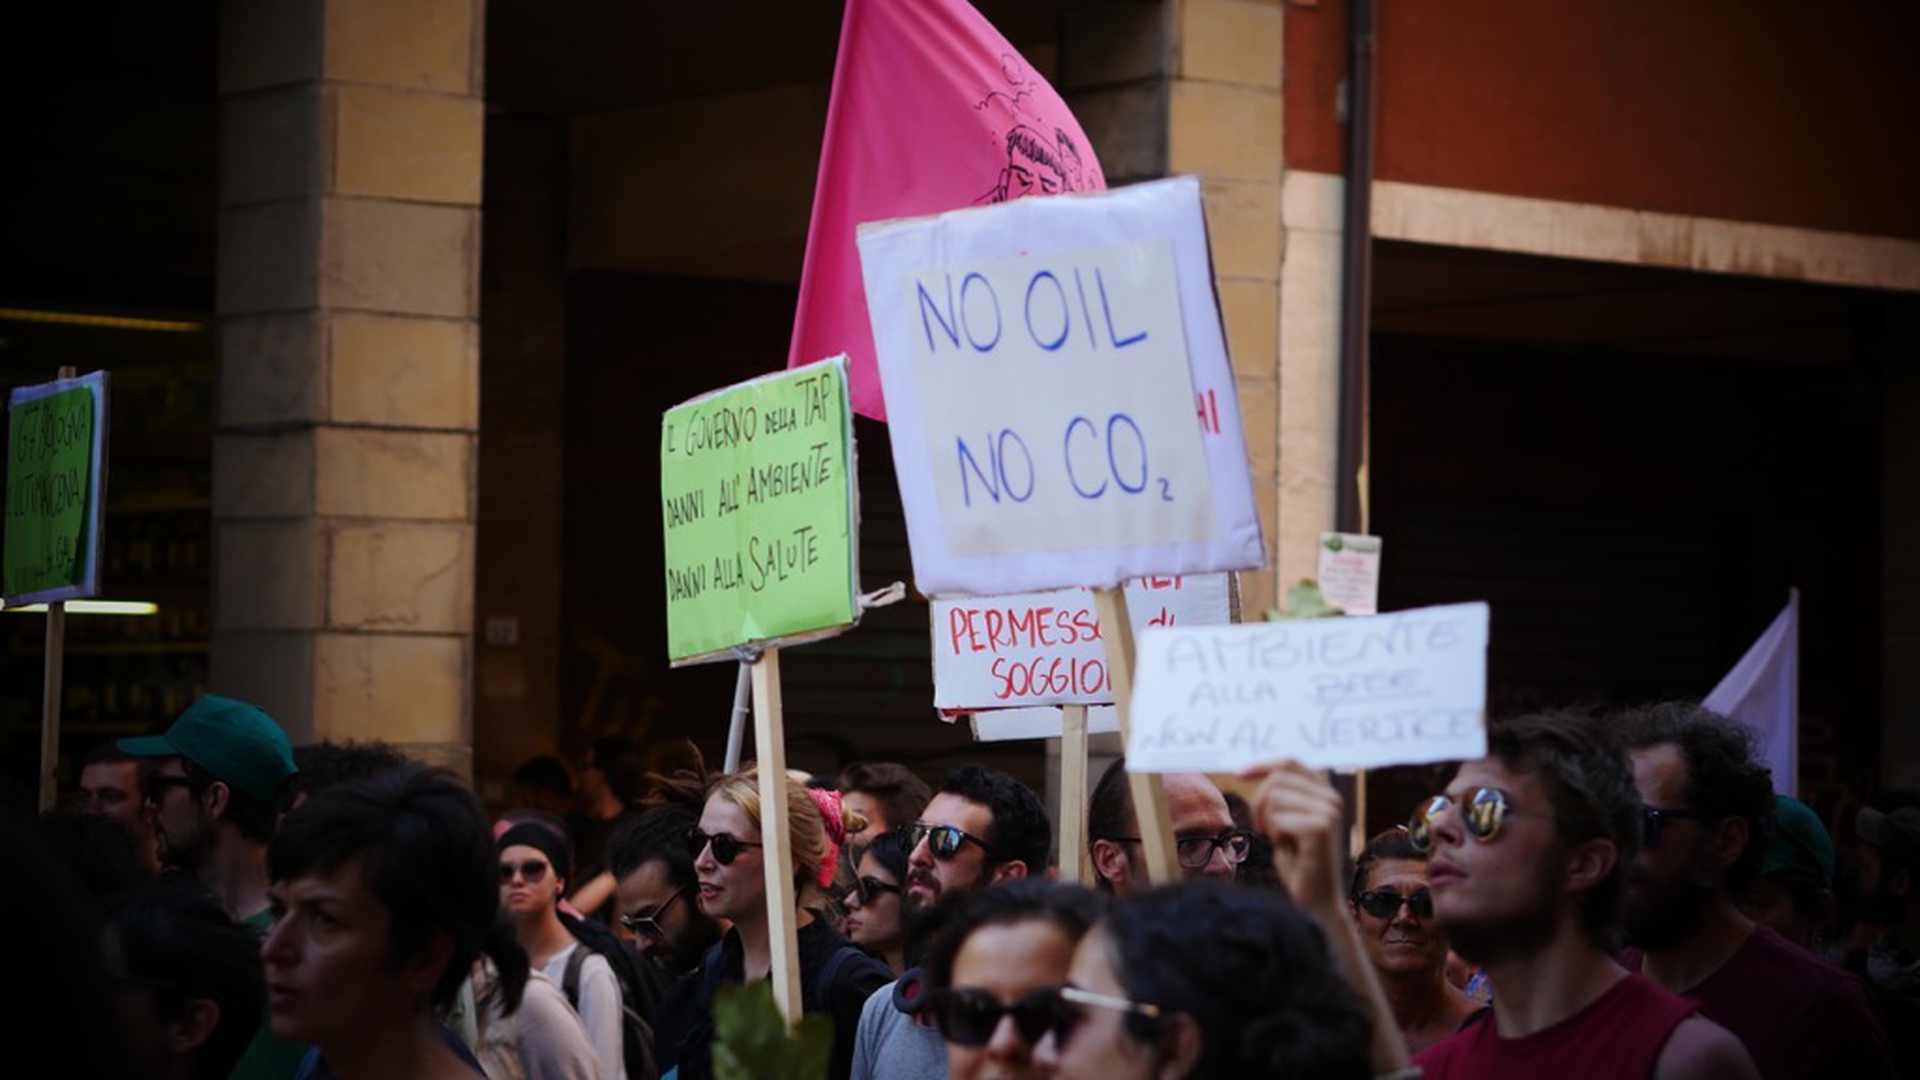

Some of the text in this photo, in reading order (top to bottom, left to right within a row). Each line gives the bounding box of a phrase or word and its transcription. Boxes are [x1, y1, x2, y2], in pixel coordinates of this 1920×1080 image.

[916, 266, 1148, 353] NO OIL
[685, 406, 757, 456] GOVERNO
[765, 407, 797, 434] DELLA
[956, 428, 1035, 508] NO
[667, 490, 705, 529] DANNI
[668, 525, 818, 602] DANNI ALLA SALUTE
[1166, 617, 1466, 676] AMBIENTE
[991, 656, 1111, 699] SOGGIO
[1188, 680, 1279, 709] ALLA
[1228, 718, 1279, 754] AL
